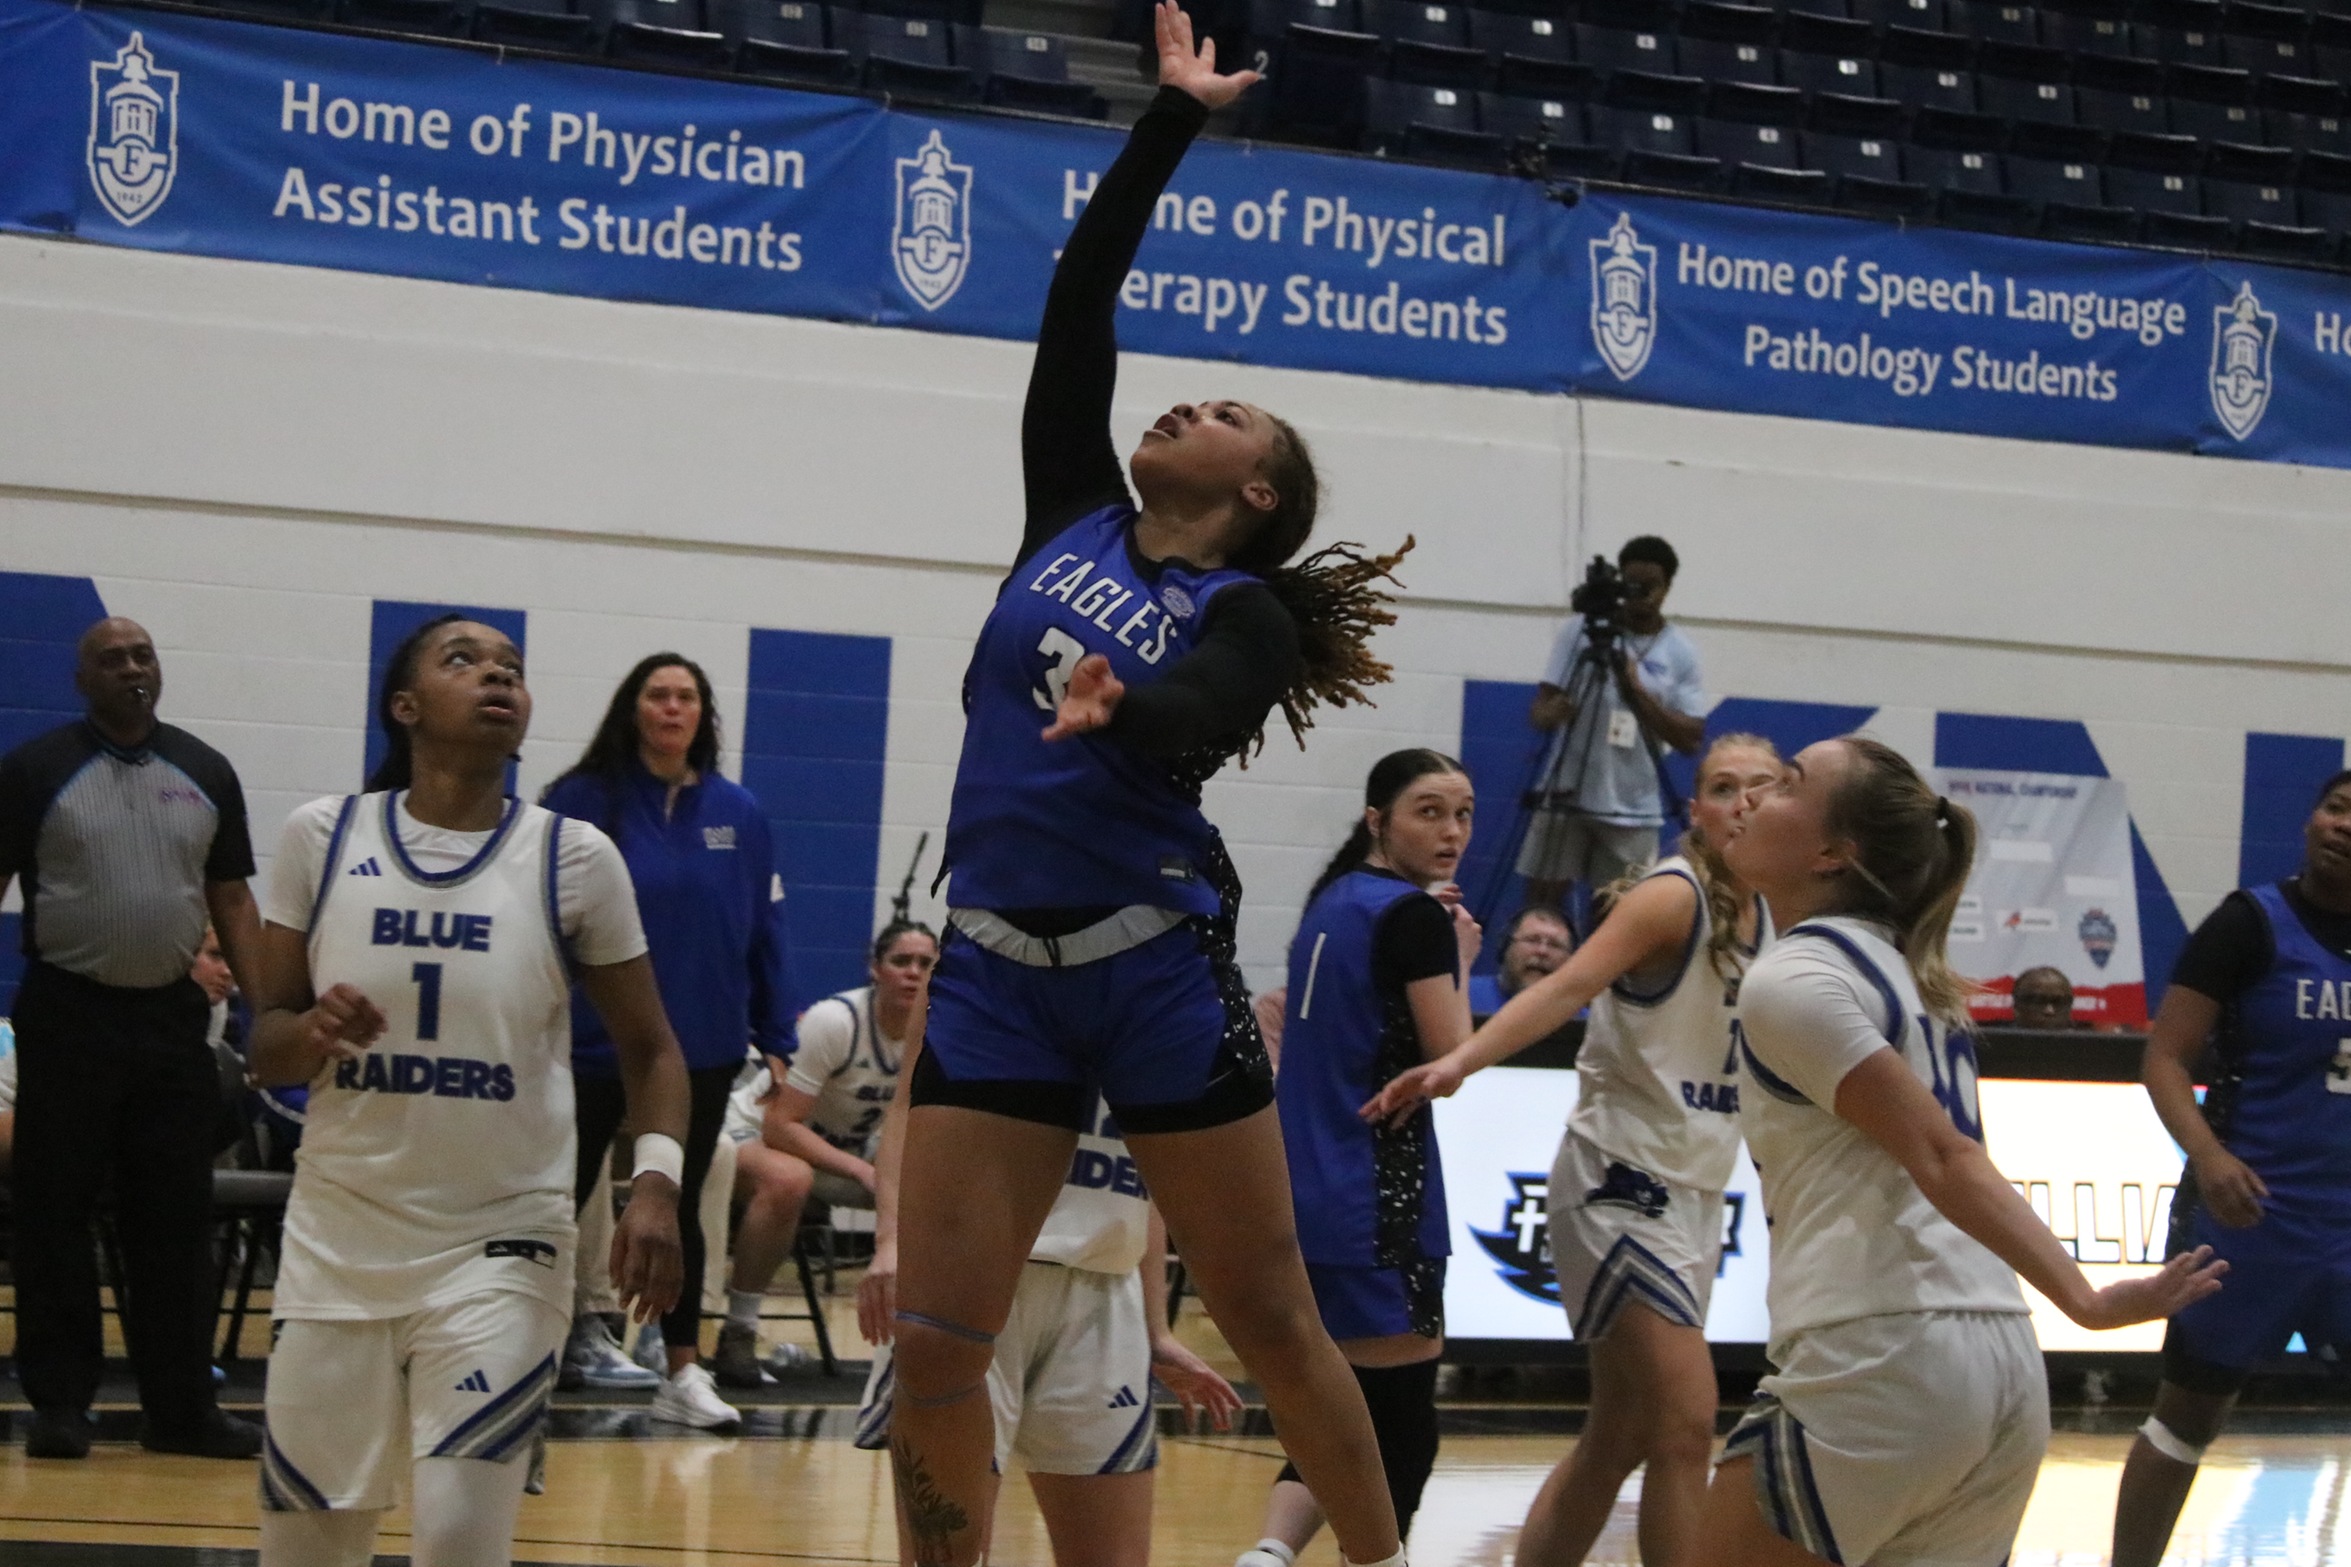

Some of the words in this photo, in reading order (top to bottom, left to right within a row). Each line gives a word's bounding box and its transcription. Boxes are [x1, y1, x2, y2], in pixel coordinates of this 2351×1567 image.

[121, 144, 145, 176] F
[281, 80, 451, 150] Home
[469, 103, 531, 157] of
[548, 111, 805, 189] Physician
[273, 167, 541, 244] Assistant
[558, 197, 803, 272] Students
[924, 234, 943, 263] F
[1062, 169, 1216, 235] Hme
[1232, 188, 1289, 242] of
[1303, 196, 1505, 268] Physical
[1053, 249, 1268, 335] erapy
[1282, 274, 1508, 346] Students
[1678, 242, 1795, 296] Home
[1805, 255, 1848, 300] of
[1857, 261, 1994, 318] Speech
[2005, 277, 2187, 347] Language
[1744, 325, 1942, 396] Pathology
[1951, 345, 2118, 401] Students
[1029, 552, 1178, 665] EAGLES
[371, 908, 493, 952] BLUE
[411, 962, 443, 1041] 1
[335, 1053, 516, 1102] RAIDERS
